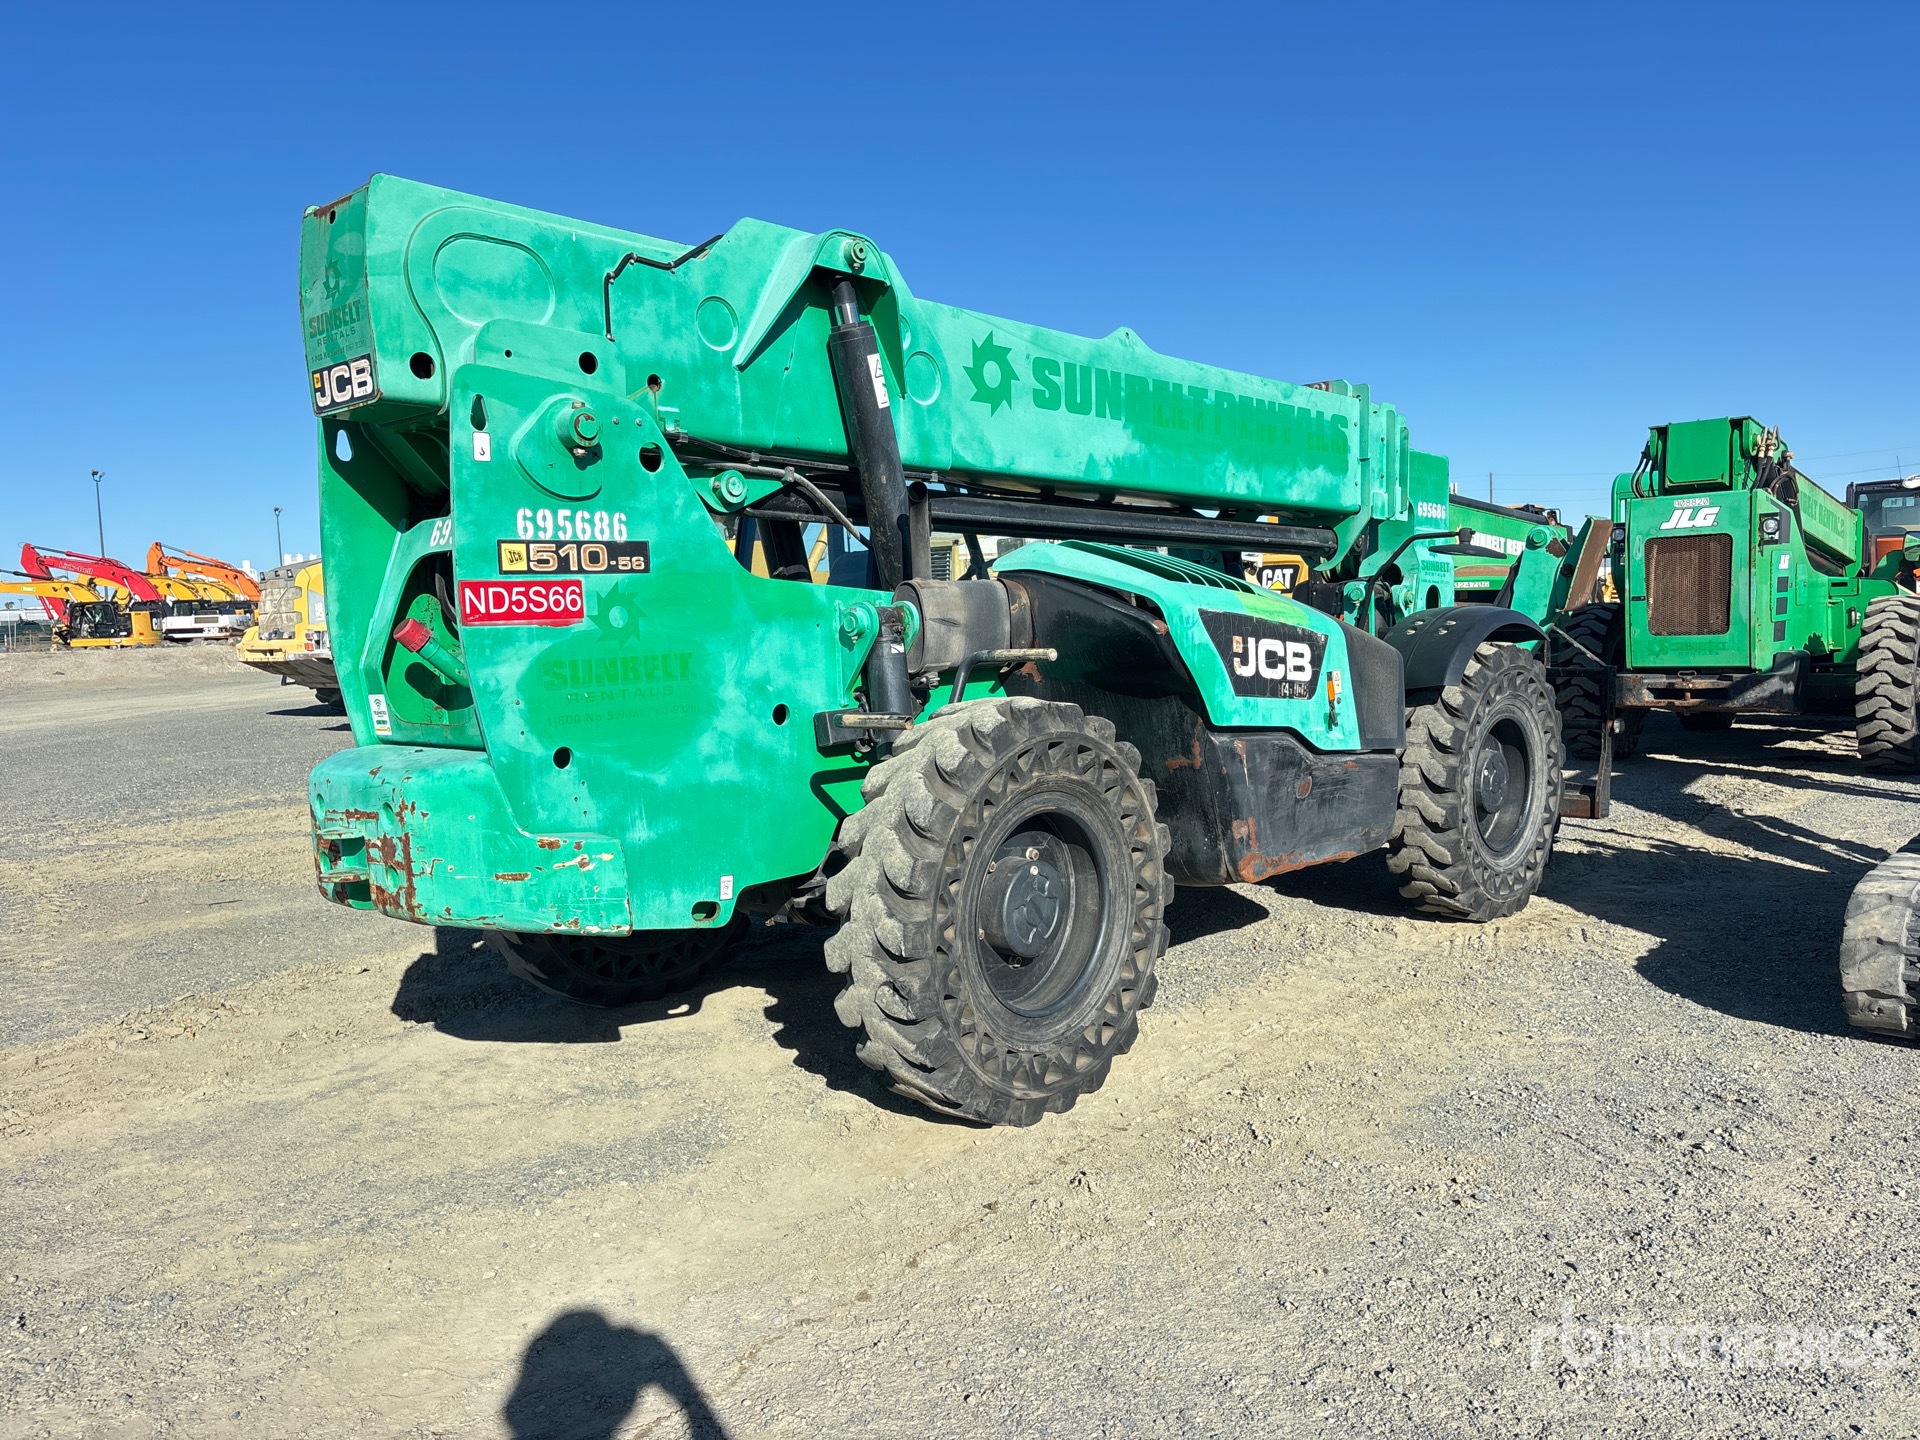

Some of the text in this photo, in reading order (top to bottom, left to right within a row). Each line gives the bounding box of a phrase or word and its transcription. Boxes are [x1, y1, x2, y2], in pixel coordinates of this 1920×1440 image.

[309, 299, 361, 339] SUNBELT
[317, 326, 356, 347] RENTALS
[314, 358, 374, 407] JCB
[1417, 501, 1446, 519] 695686
[1659, 506, 1722, 530] JLG
[430, 519, 453, 547] 69
[516, 508, 628, 543] 695686
[508, 543, 645, 571] JCB 510-56
[1421, 560, 1450, 573] SUNBELT
[1262, 568, 1294, 590] CAT
[464, 585, 582, 615] ND5S66
[543, 652, 694, 691] SUNBELT
[1232, 635, 1313, 681] JCB
